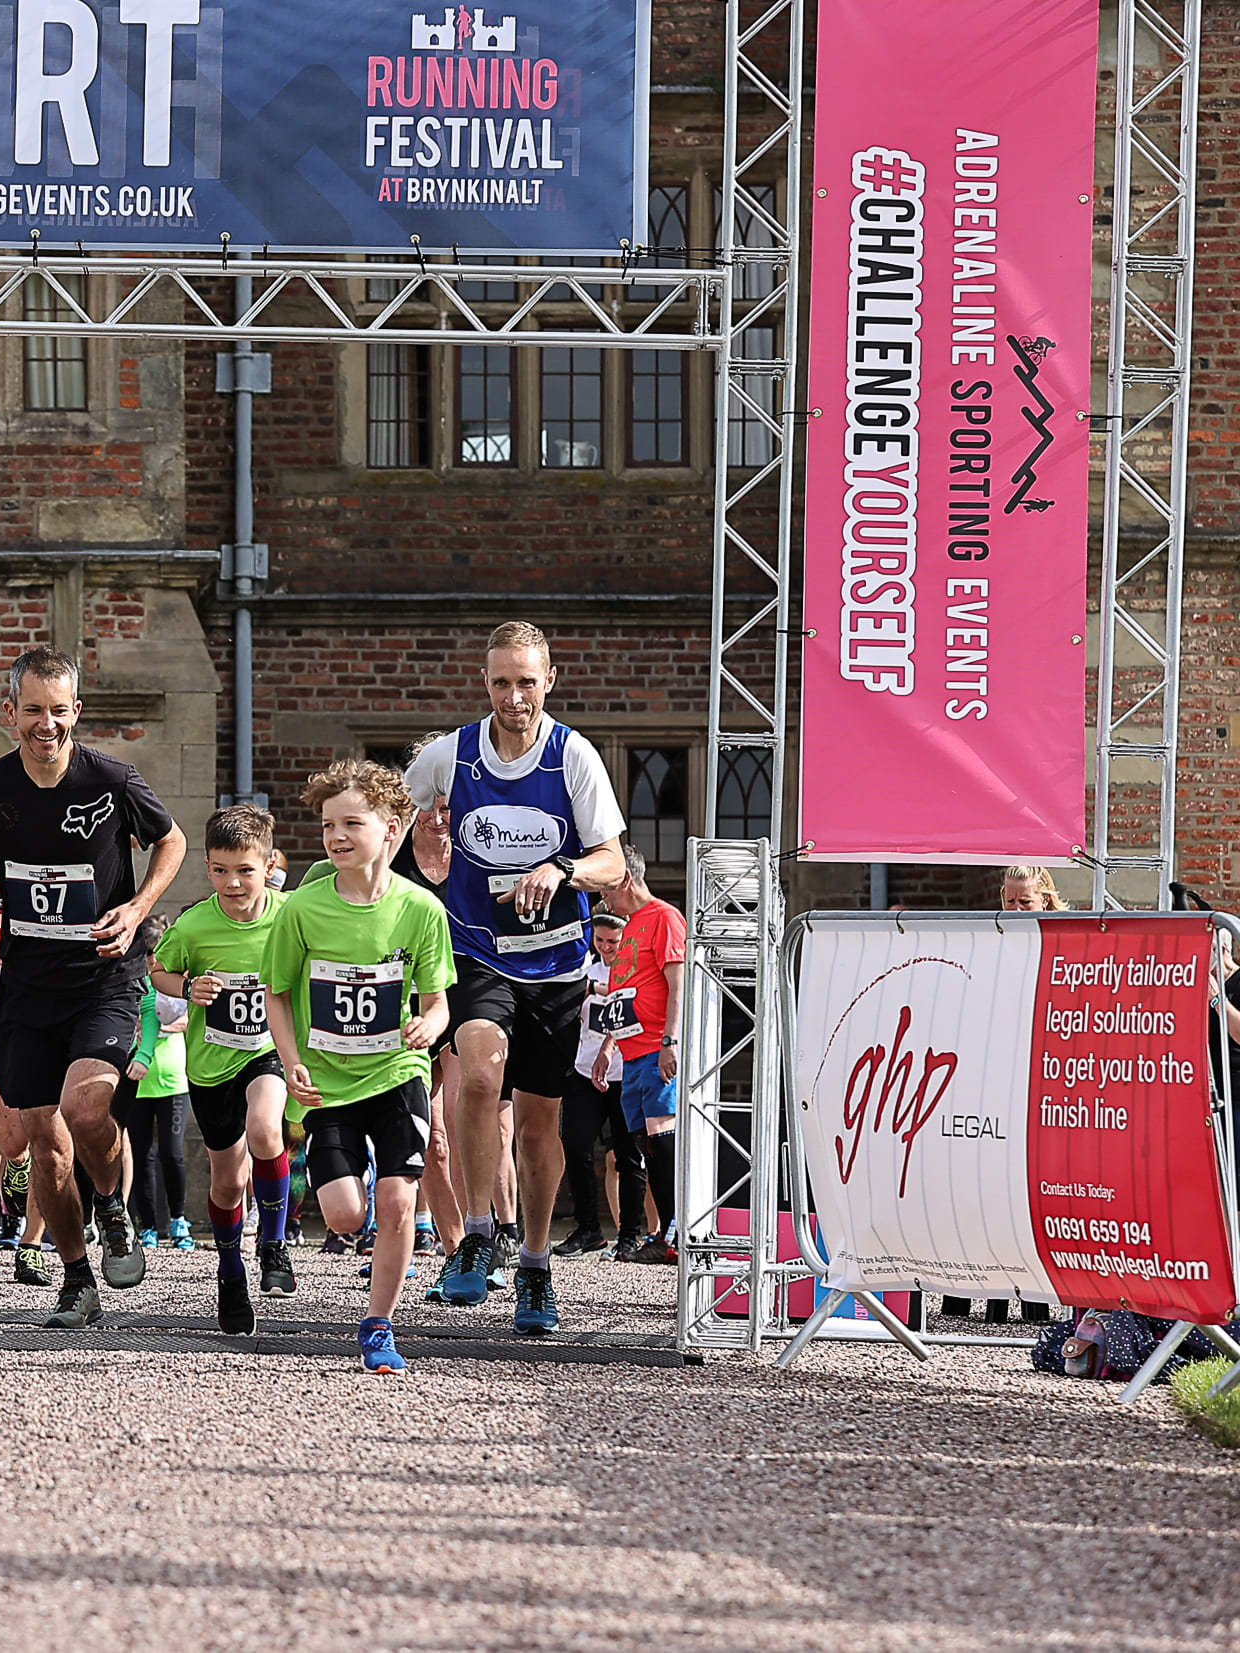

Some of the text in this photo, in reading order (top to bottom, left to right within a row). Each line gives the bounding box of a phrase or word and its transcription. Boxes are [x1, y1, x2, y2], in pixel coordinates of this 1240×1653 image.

[367, 55, 559, 110] RUNNING
[365, 115, 564, 169] FESTIVAL
[378, 177, 544, 204] AT BRYNKINALT
[840, 147, 925, 696] #CHALLENGEYOURSELF
[944, 127, 999, 721] ADRENALINE SPORTING EVENTS
[498, 827, 550, 842] mind
[30, 883, 67, 914] 67
[40, 914, 64, 923] CHRIS
[531, 922, 546, 933] TIM
[1050, 955, 1197, 993] Expertly tailored
[229, 990, 267, 1024] 68
[334, 984, 377, 1023] 56
[608, 1000, 625, 1024] 42
[235, 1024, 261, 1033] ETHAN
[343, 1024, 367, 1034] RHYS
[1045, 1001, 1176, 1040] legal solutions
[1042, 1051, 1194, 1089] to get you to the
[835, 1005, 958, 1198] ghp
[1040, 1095, 1128, 1130] finish line
[941, 1115, 1006, 1139] LEGAL
[1040, 1181, 1115, 1202] Contact Us Today:
[1044, 1215, 1151, 1245] 01691 659 194
[1050, 1249, 1209, 1280] www.ghplegal.com
